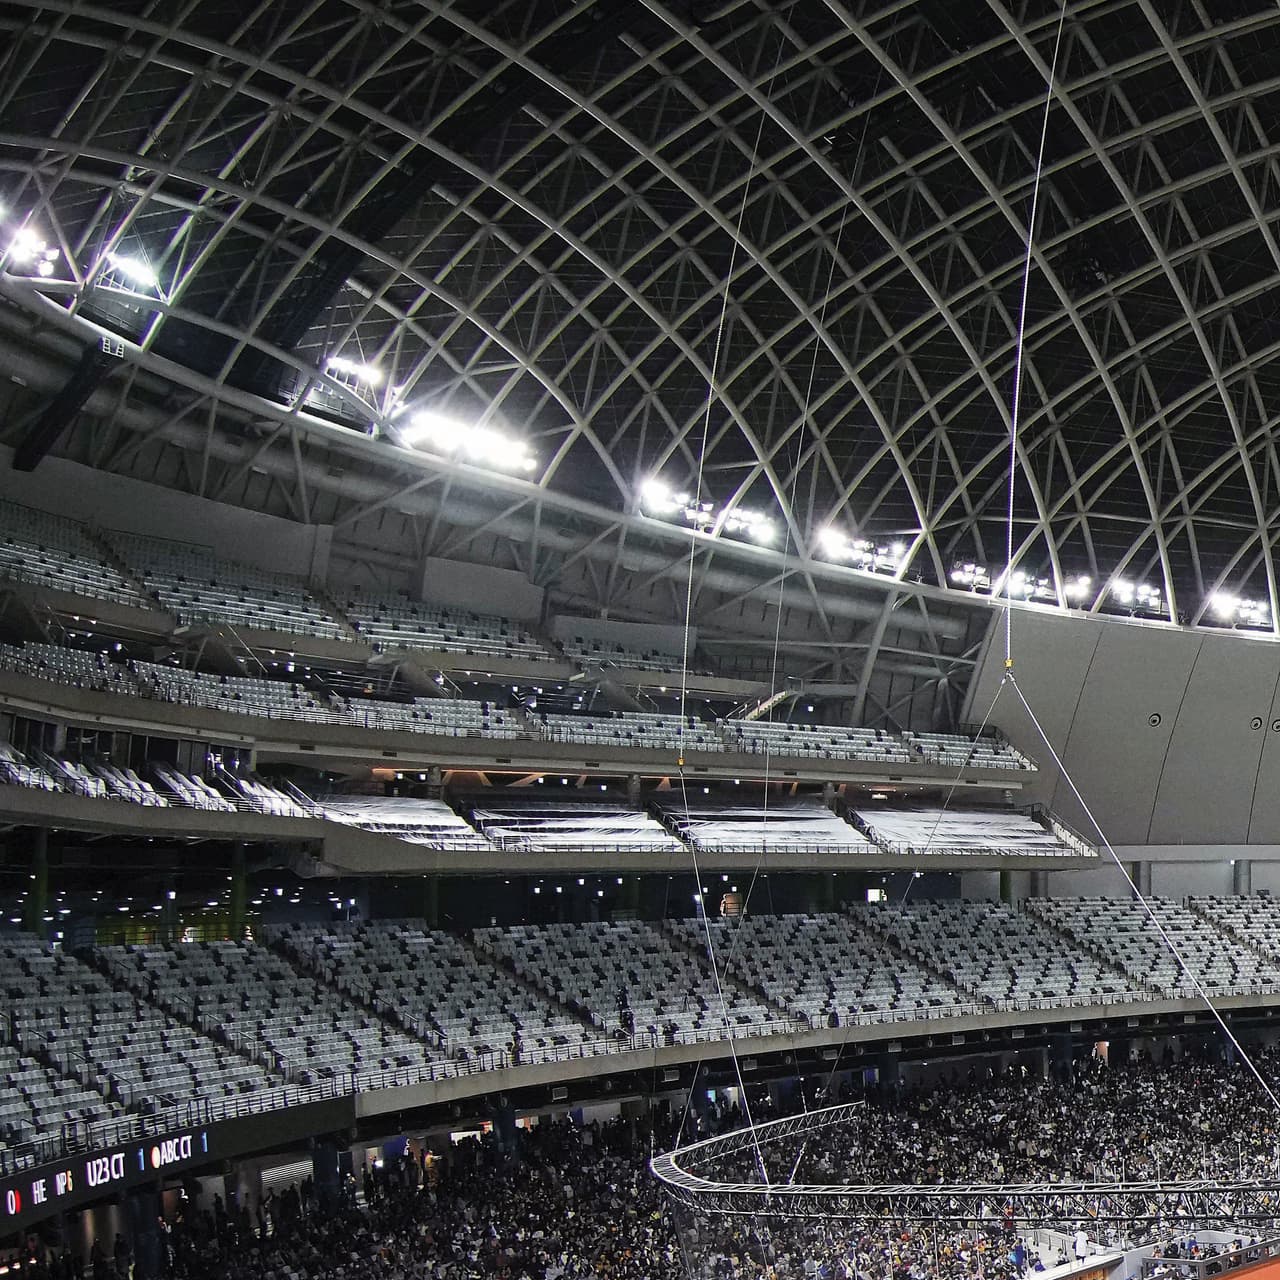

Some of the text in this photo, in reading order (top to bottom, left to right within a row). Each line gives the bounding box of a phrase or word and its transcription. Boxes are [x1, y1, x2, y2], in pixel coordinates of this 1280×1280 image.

[87, 1157, 110, 1187] U23
[111, 1153, 125, 1180] CT
[138, 1148, 144, 1171] 1
[160, 1139, 179, 1166] ABC
[180, 1135, 192, 1160] CT
[202, 1132, 208, 1153] 1
